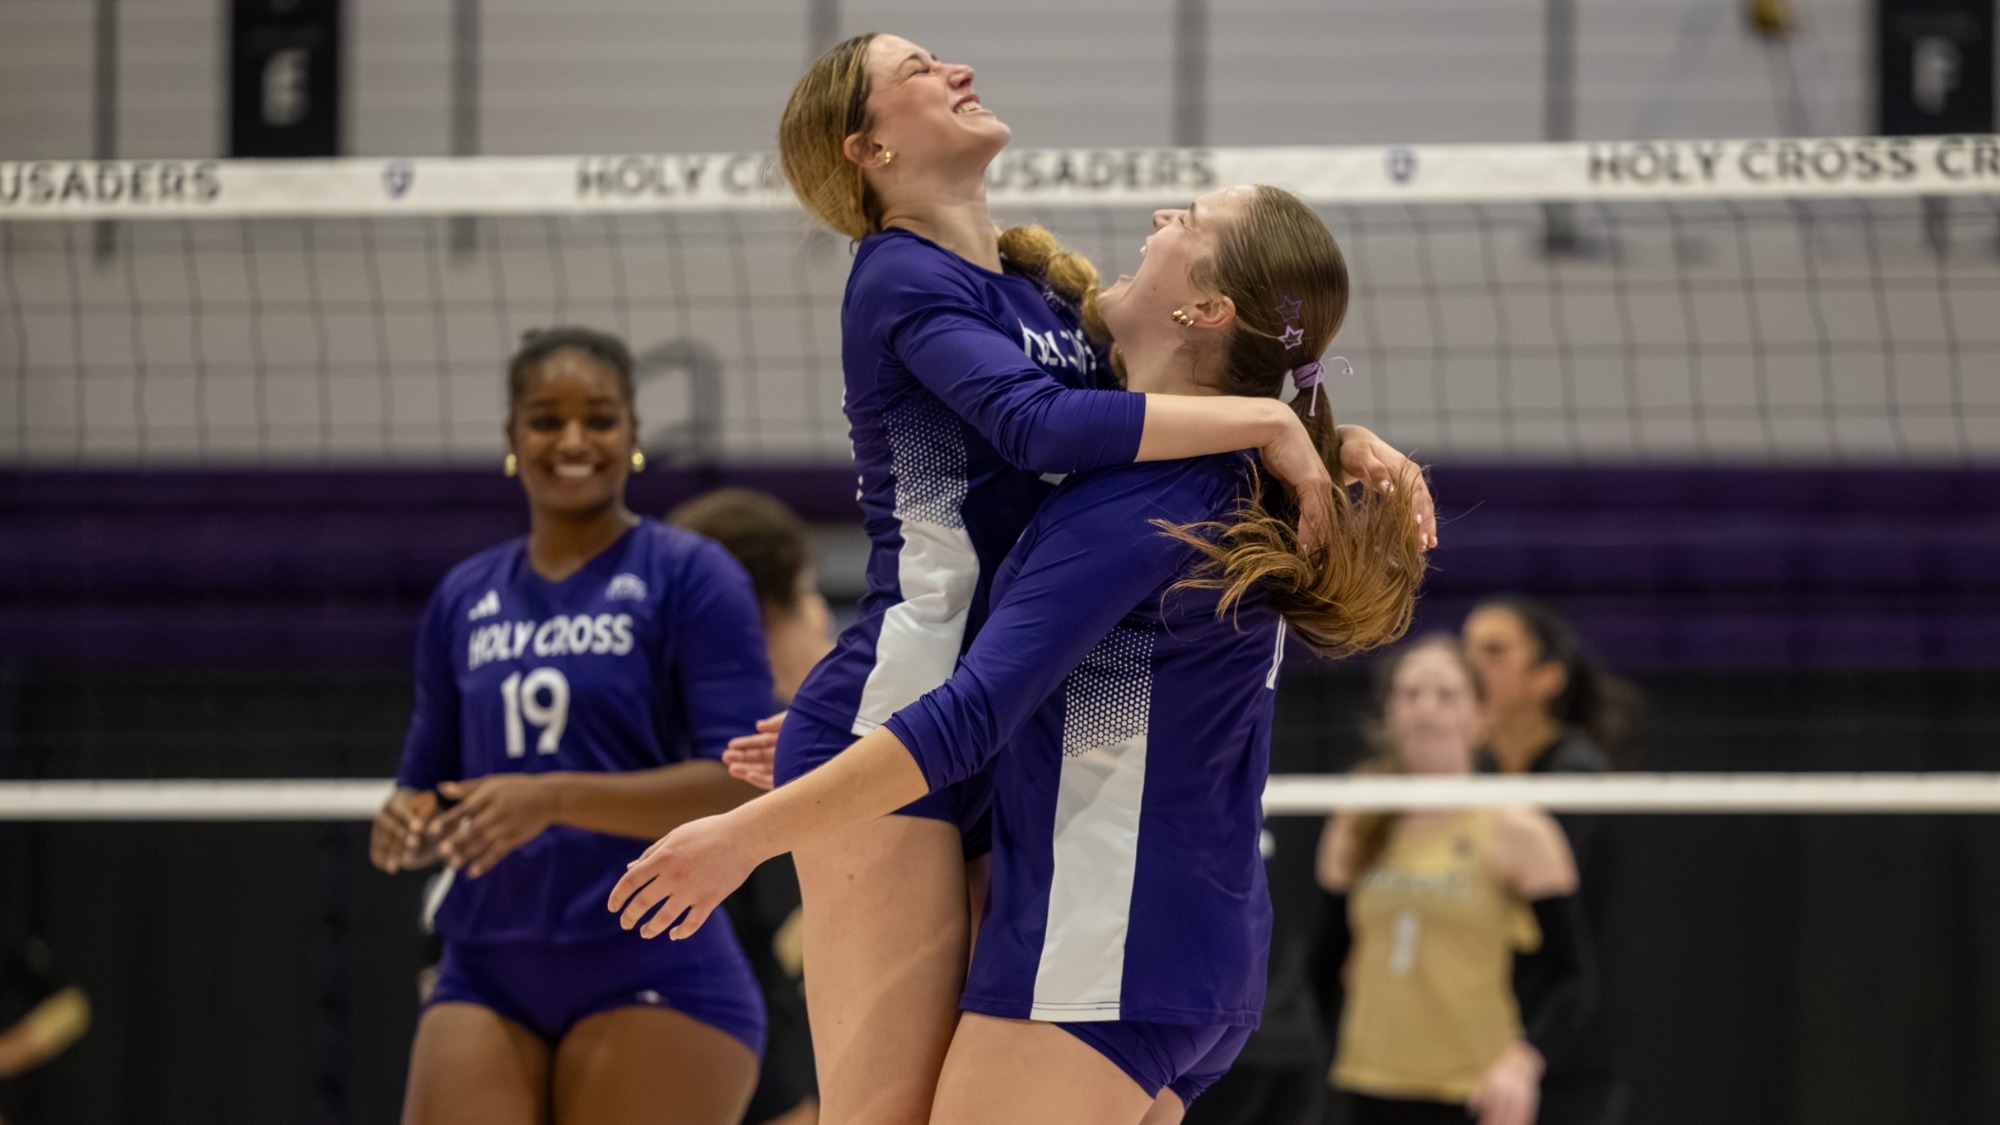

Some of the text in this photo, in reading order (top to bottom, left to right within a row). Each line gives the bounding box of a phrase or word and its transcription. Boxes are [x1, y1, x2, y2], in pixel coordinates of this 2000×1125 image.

[577, 153, 712, 196] HOLY
[1588, 141, 1726, 185] HOLY
[1738, 137, 1918, 183] CROSS
[468, 612, 635, 671] HOLY CROSS
[501, 666, 571, 759] 19
